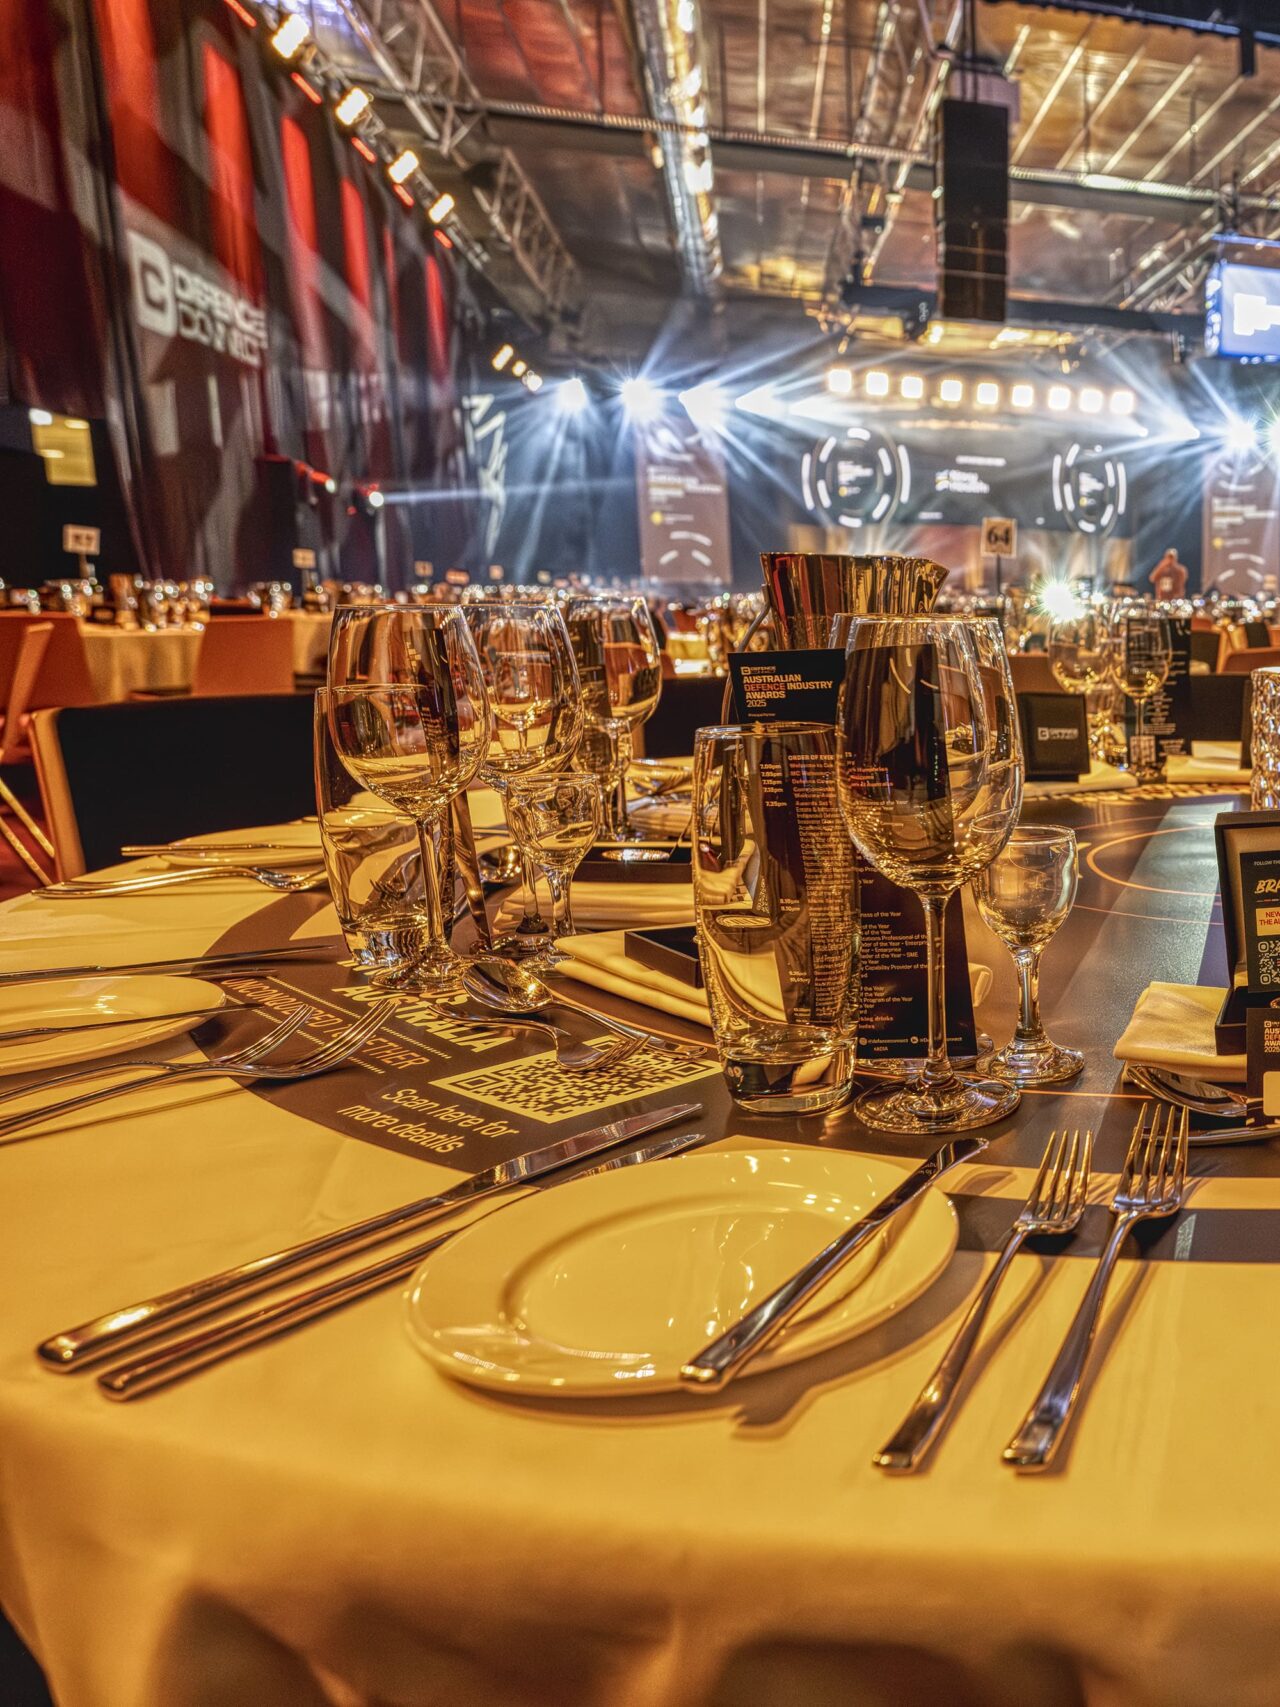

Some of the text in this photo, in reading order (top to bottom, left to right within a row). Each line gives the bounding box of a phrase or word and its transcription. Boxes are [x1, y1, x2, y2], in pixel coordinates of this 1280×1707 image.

[986, 526, 1011, 546] 64
[743, 674, 801, 684] AUSTRALIAN
[744, 681, 833, 691] DEFENCE INDUSTRY
[746, 691, 786, 699] AWARDS
[746, 699, 767, 708] 2025
[1258, 918, 1273, 926] THE
[337, 1104, 396, 1128] more
[381, 1088, 519, 1138] Scan here for
